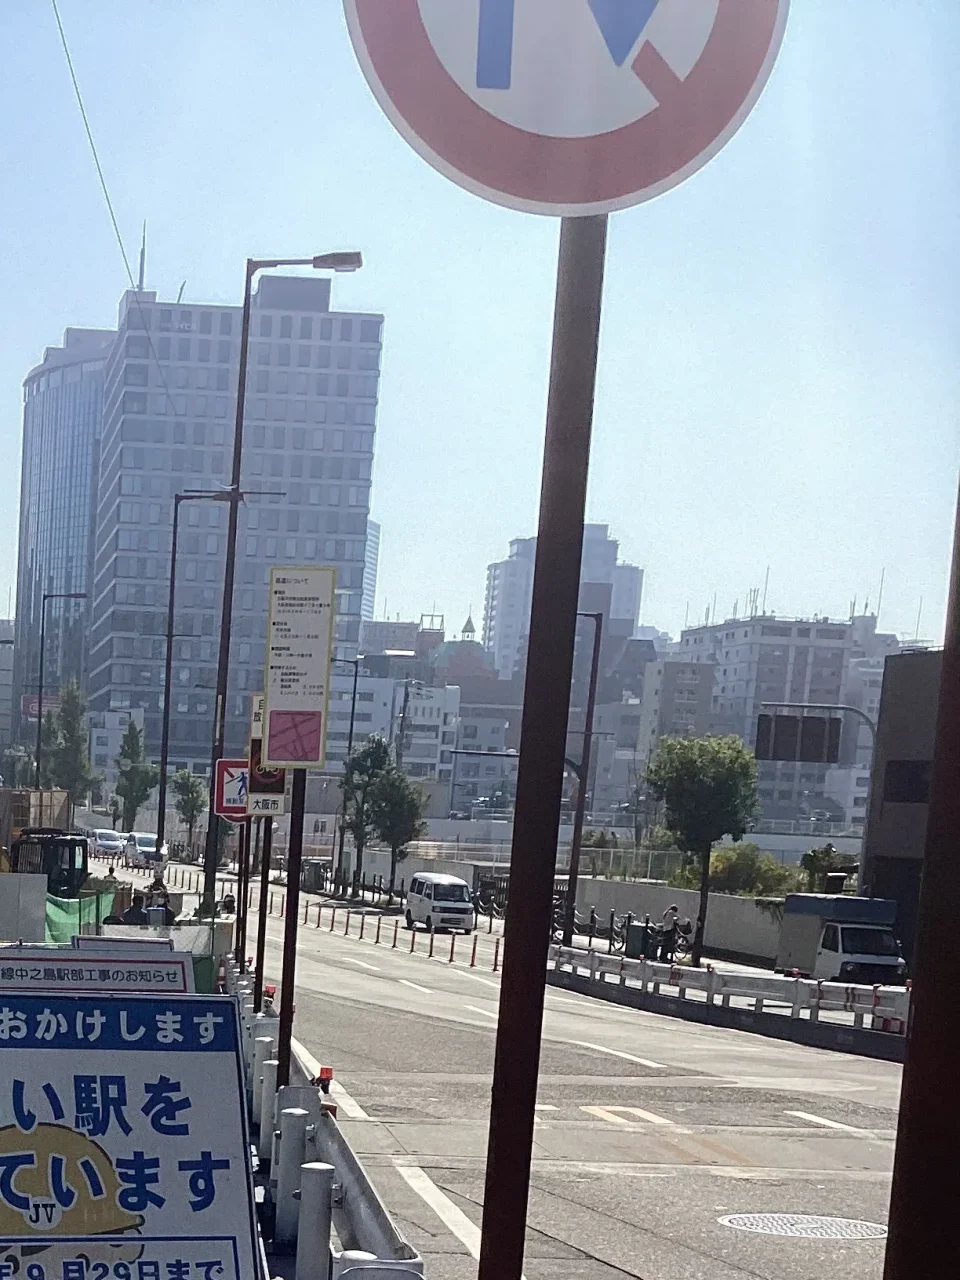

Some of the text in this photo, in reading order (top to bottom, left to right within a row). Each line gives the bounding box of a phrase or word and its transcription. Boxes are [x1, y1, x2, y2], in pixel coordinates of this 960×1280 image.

[253, 799, 279, 811] 大阪市
[29, 1203, 57, 1225] JV
